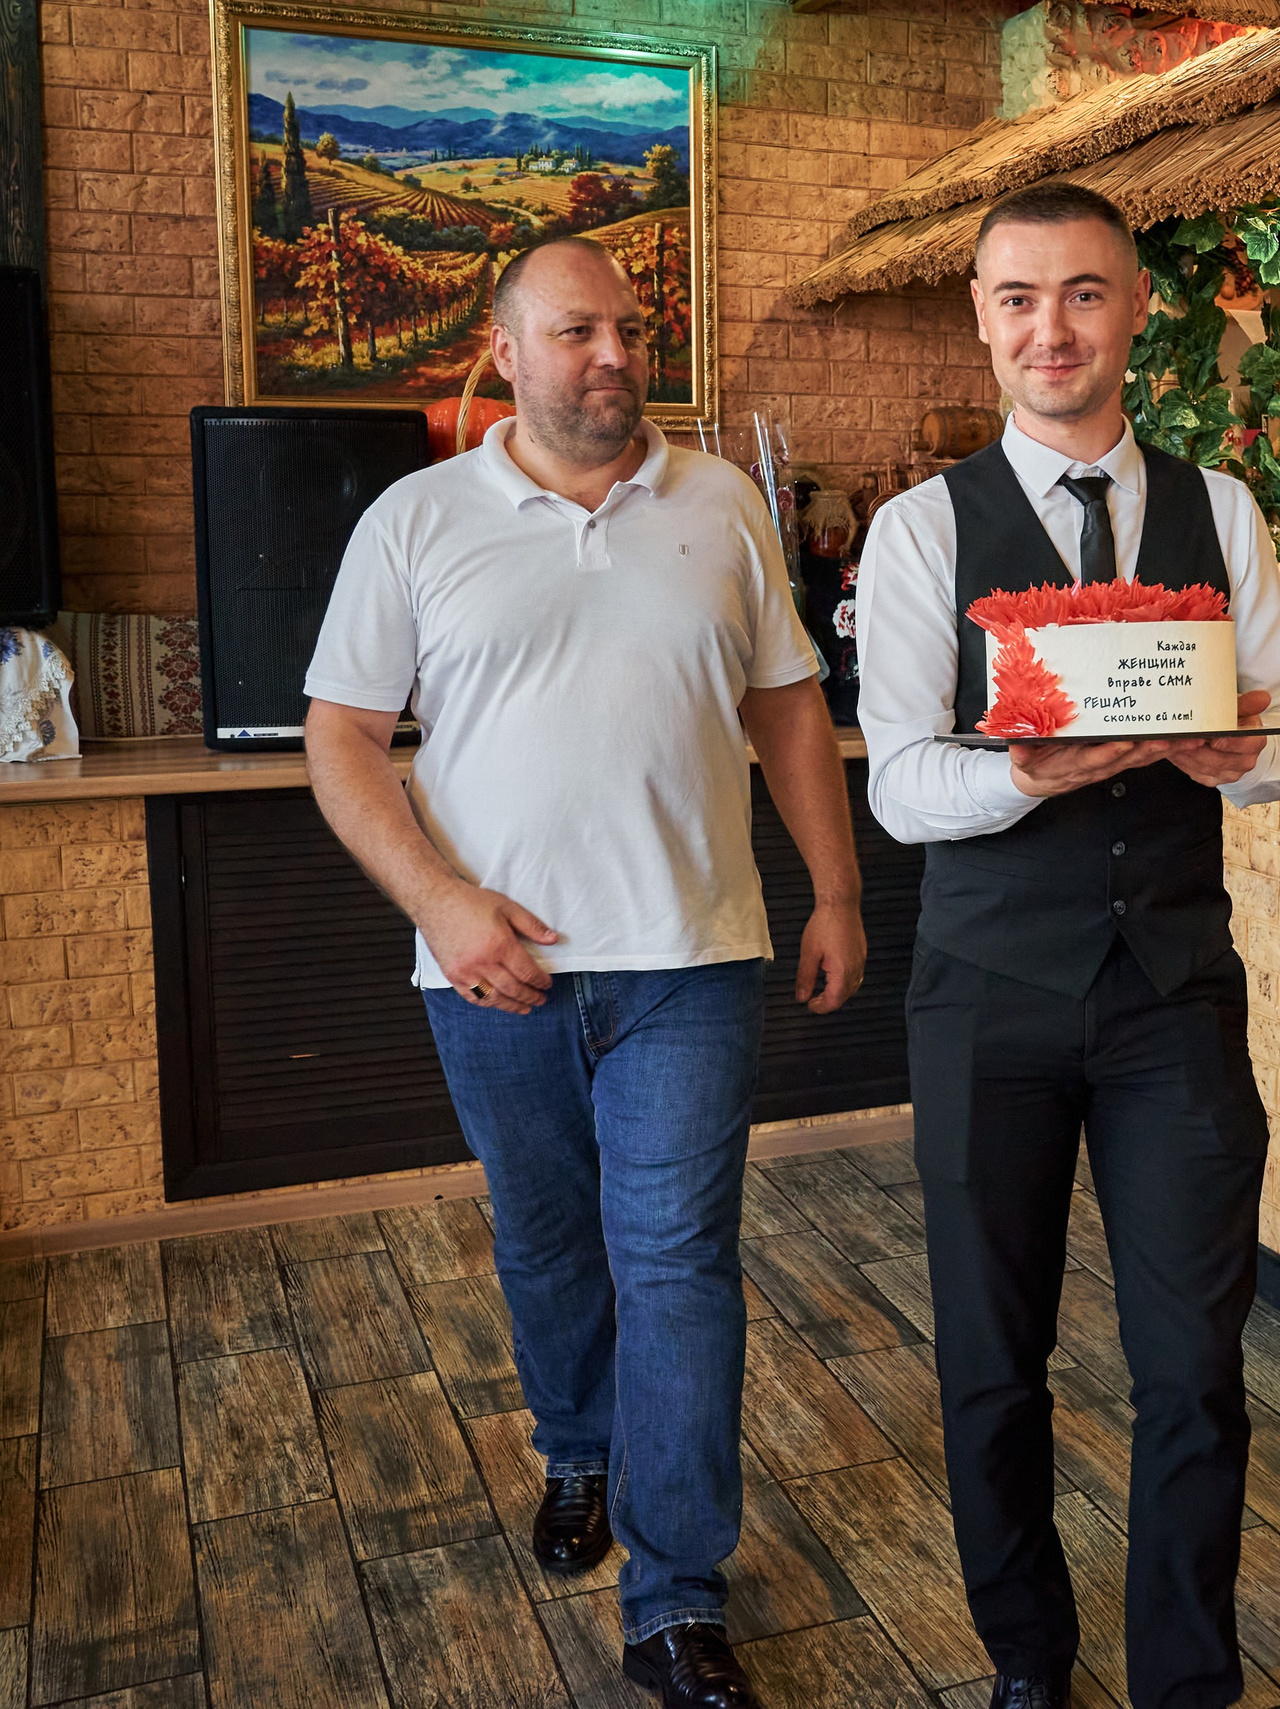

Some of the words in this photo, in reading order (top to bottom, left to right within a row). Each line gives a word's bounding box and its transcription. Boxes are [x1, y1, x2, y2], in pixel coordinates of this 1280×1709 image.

[1157, 640, 1197, 652] Каждая
[1117, 657, 1186, 670] ЖЕНЩИНА
[1107, 676, 1152, 693] вправе
[1158, 674, 1194, 687] САМА
[1083, 695, 1137, 709] РЕШАТЬ
[1103, 713, 1152, 723] сколько
[1155, 711, 1169, 722] ей
[1171, 709, 1194, 721] лет!
